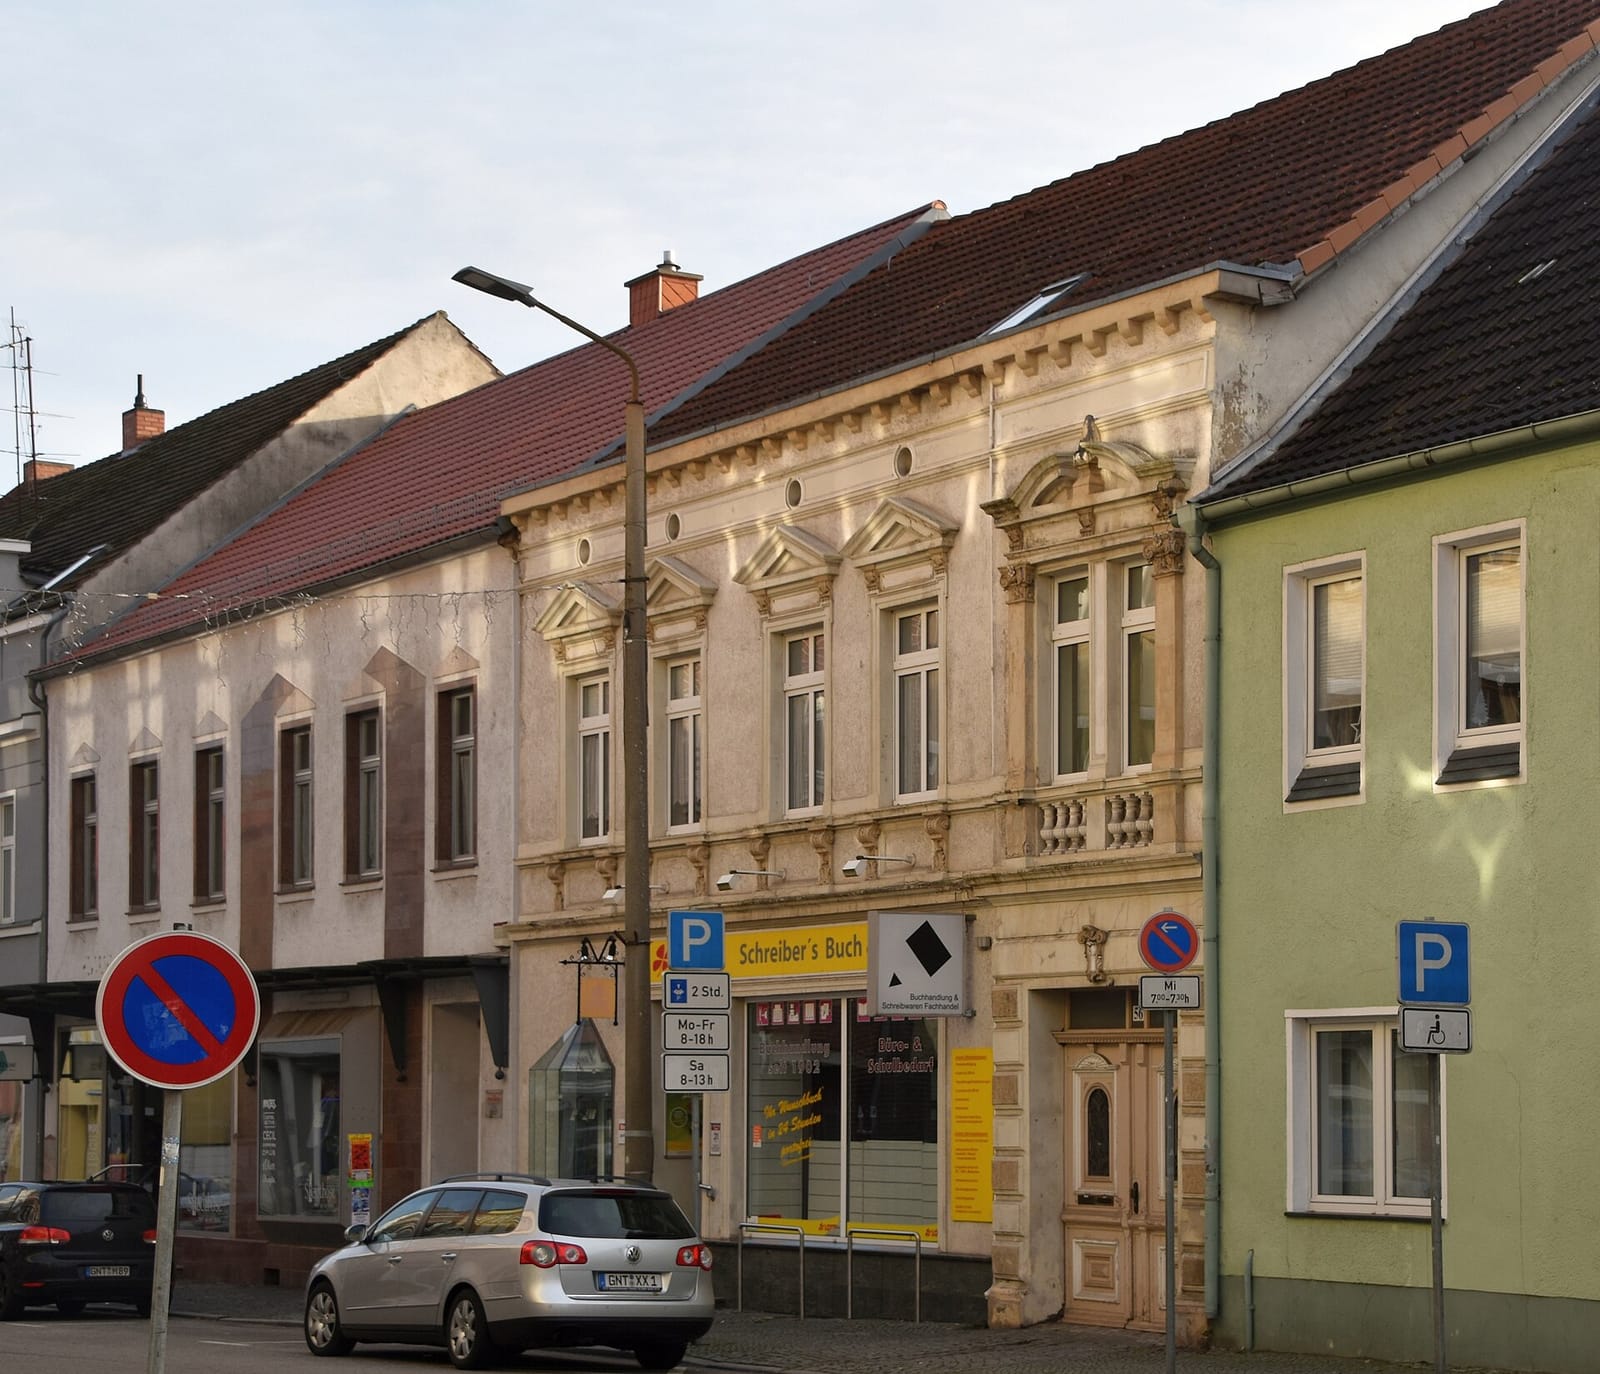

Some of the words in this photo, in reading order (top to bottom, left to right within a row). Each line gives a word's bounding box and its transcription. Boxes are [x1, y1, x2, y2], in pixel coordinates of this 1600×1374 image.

[682, 918, 711, 962] P
[826, 934, 862, 958] Buch
[1415, 932, 1452, 993] P
[691, 986, 698, 997] 2
[701, 985, 724, 997] Std.
[1164, 981, 1177, 991] Mi
[910, 993, 952, 1002] Buchhandlung
[882, 1002, 922, 1010] Schreibwaren
[678, 1019, 715, 1031] Mo-Fr
[878, 1037, 909, 1053] Büro-
[913, 1036, 922, 1052] &
[689, 1060, 705, 1071] Sa
[867, 1056, 934, 1074] Schulbedarf
[609, 1274, 629, 1286] GNT
